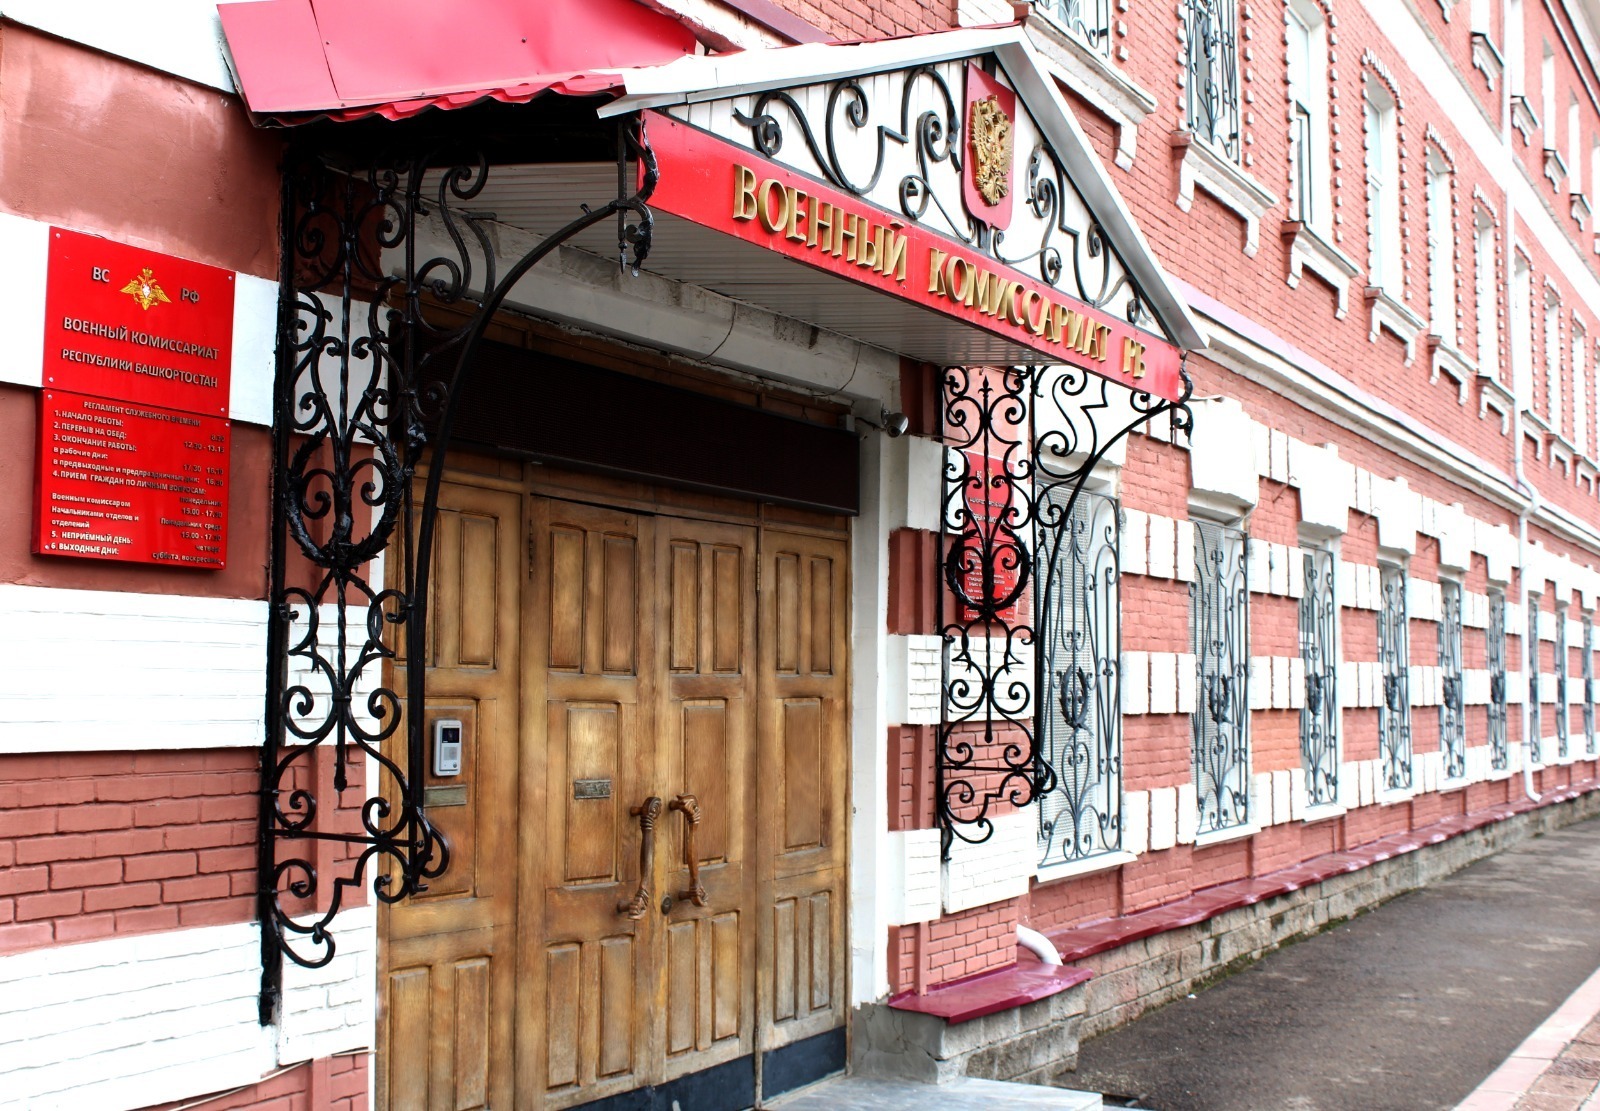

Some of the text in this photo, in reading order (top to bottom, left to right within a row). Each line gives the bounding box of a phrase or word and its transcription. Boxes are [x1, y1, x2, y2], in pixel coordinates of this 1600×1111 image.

[732, 164, 1146, 379] ВОЕННЫЙ КОМИССАРИАТ РБ
[92, 266, 200, 303] ВС РФ
[63, 317, 219, 360] ВОЕННЫЙ КОМИССАРИАТ
[62, 348, 218, 388] РЕСПУБЛИКИ БАШКОРТОСТАН
[62, 411, 92, 422] НАЧАЛО
[94, 416, 124, 427] РАБОТЫ:
[84, 401, 200, 427] РЕГЛАМЕНТ СЛУЖЕБНОГО ВРЕМЕНИ
[53, 421, 61, 429] 2.
[61, 423, 94, 434] ПЕРЕРЫВ
[95, 428, 105, 436] НА
[106, 430, 127, 439] ОБЕД:
[53, 433, 137, 451] 3. ОКОНЧАНИЕ РАБОТЫ:
[60, 447, 91, 458] рабочие
[92, 452, 108, 460] дни:
[59, 460, 115, 473] предвыходные
[122, 467, 184, 482] предпраздничные
[52, 470, 206, 495] 4. ПРИЕМ ГРАЖДАН ПО ЛИЧНЫМ ВОПРОСАМ:
[52, 492, 131, 508] Военным комиссаром
[51, 506, 104, 519] Начальниками
[105, 513, 133, 522] отделов
[52, 518, 90, 528] отделений
[61, 531, 112, 543] НЕПРИЁМНЫЙ
[113, 536, 133, 545] ДЕНЬ:
[51, 542, 119, 555] 6. ВЫХОДНЫЕ ДНИ:
